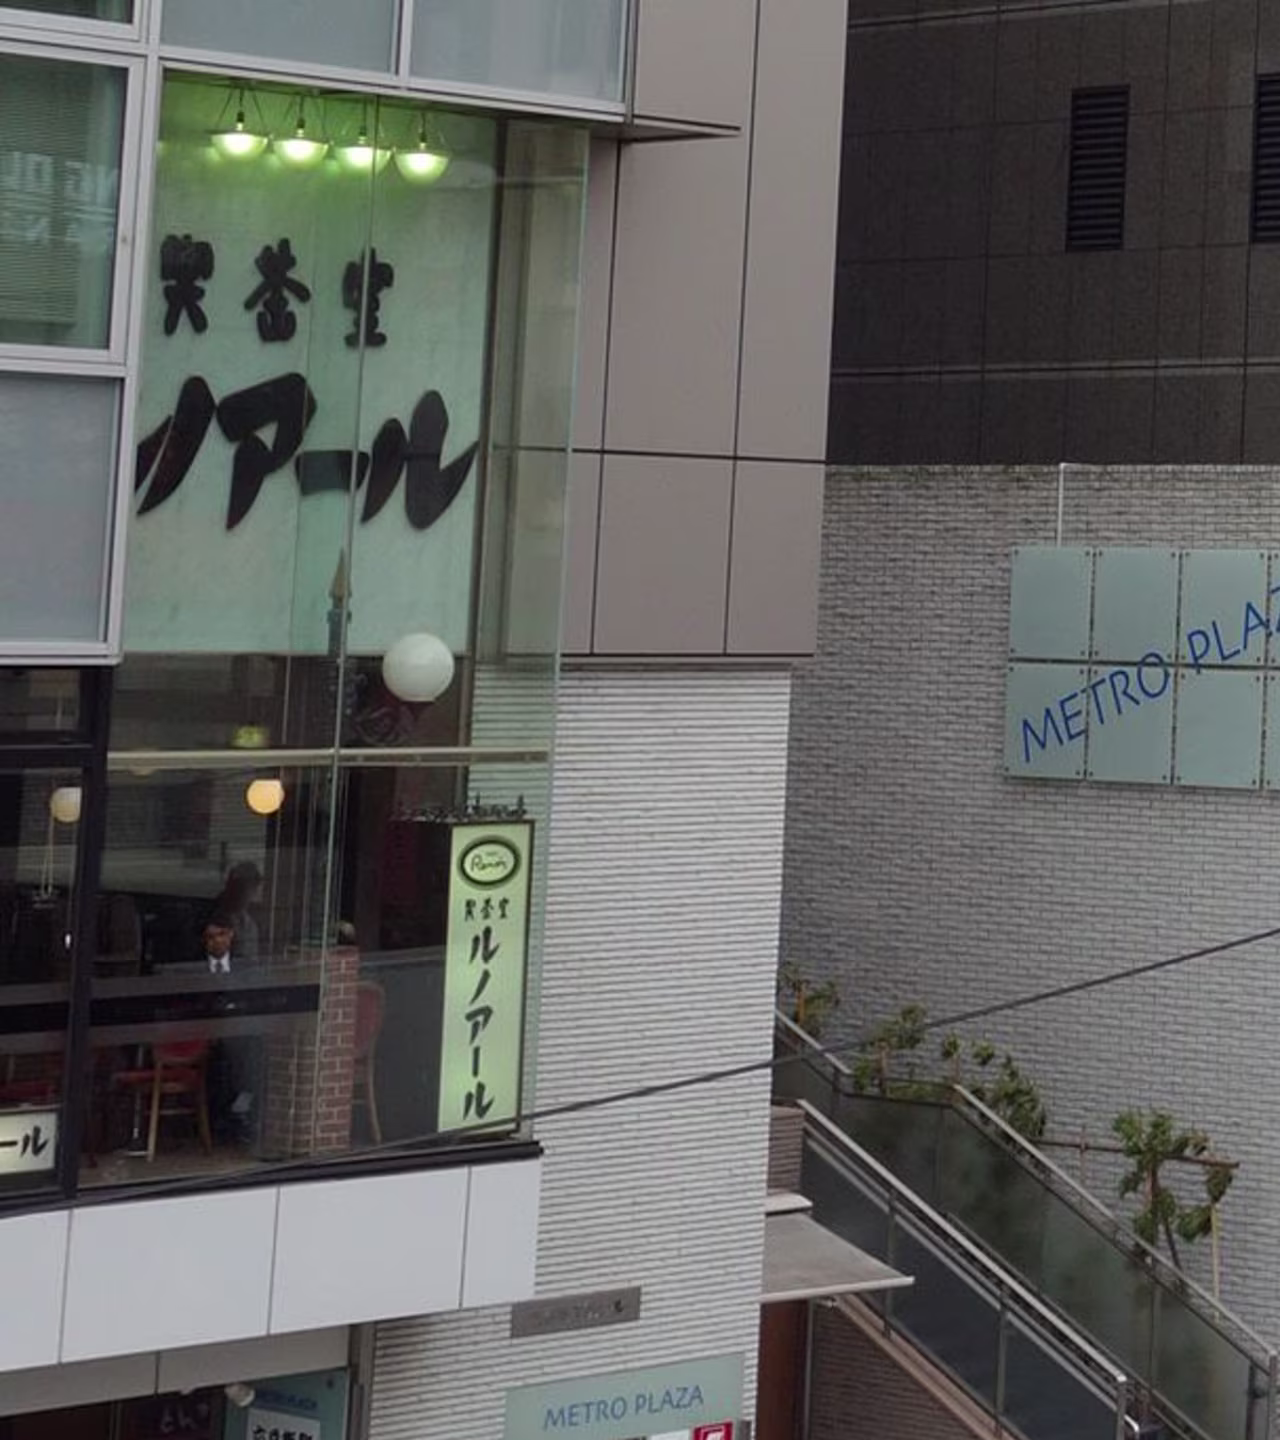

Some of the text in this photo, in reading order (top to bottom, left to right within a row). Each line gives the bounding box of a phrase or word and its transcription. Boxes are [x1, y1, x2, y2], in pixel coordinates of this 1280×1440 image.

[1021, 652, 1170, 763] METRO
[464, 926, 501, 1120] ルノアール
[543, 1384, 705, 1432] METRO PLAZA
